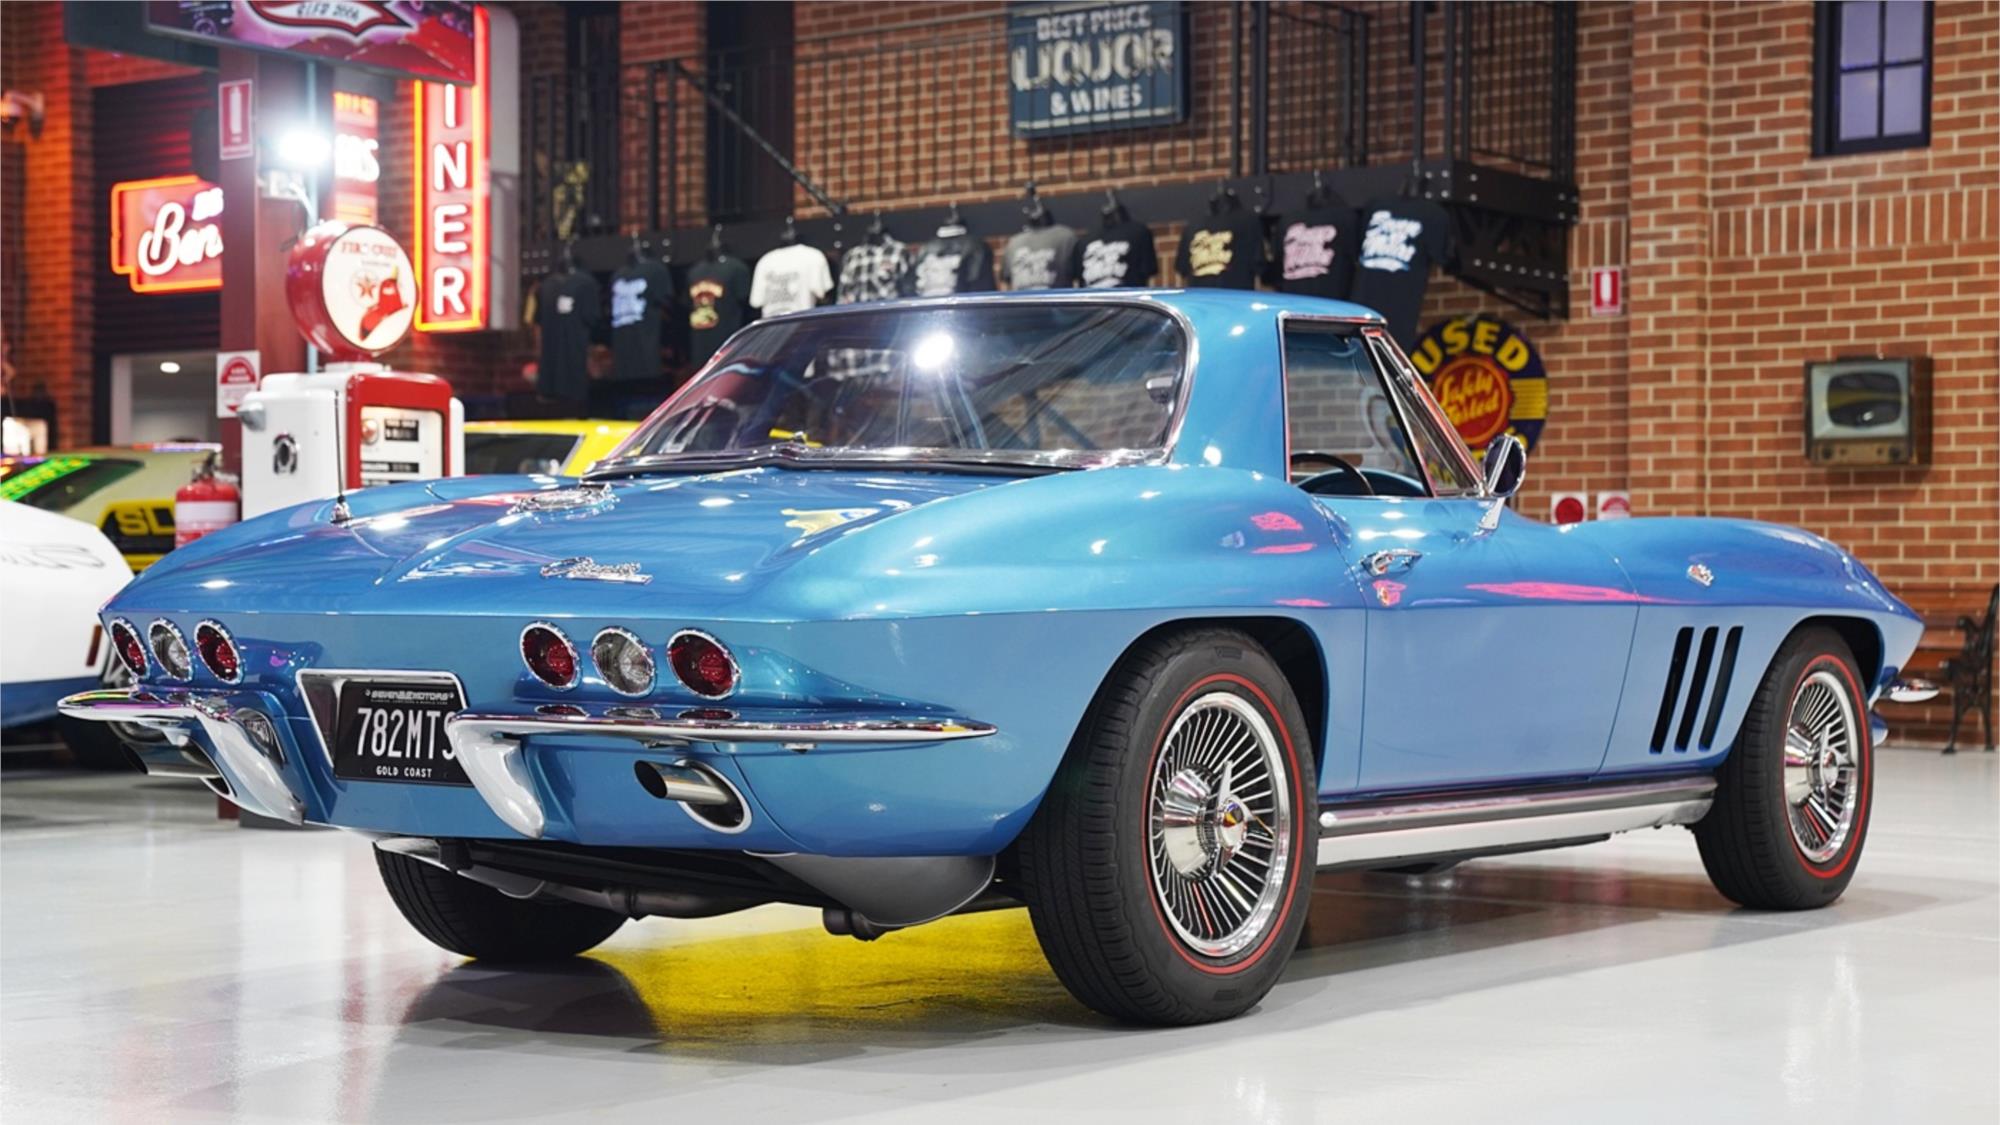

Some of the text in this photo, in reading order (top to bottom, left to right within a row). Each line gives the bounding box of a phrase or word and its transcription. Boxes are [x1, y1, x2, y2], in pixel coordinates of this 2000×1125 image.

[1036, 5, 1152, 41] BEST PRICE
[1051, 84, 1143, 116] & WINES
[1411, 318, 1530, 375] USED
[357, 707, 457, 760] 782MTS
[375, 765, 433, 778] GOLD COAST
